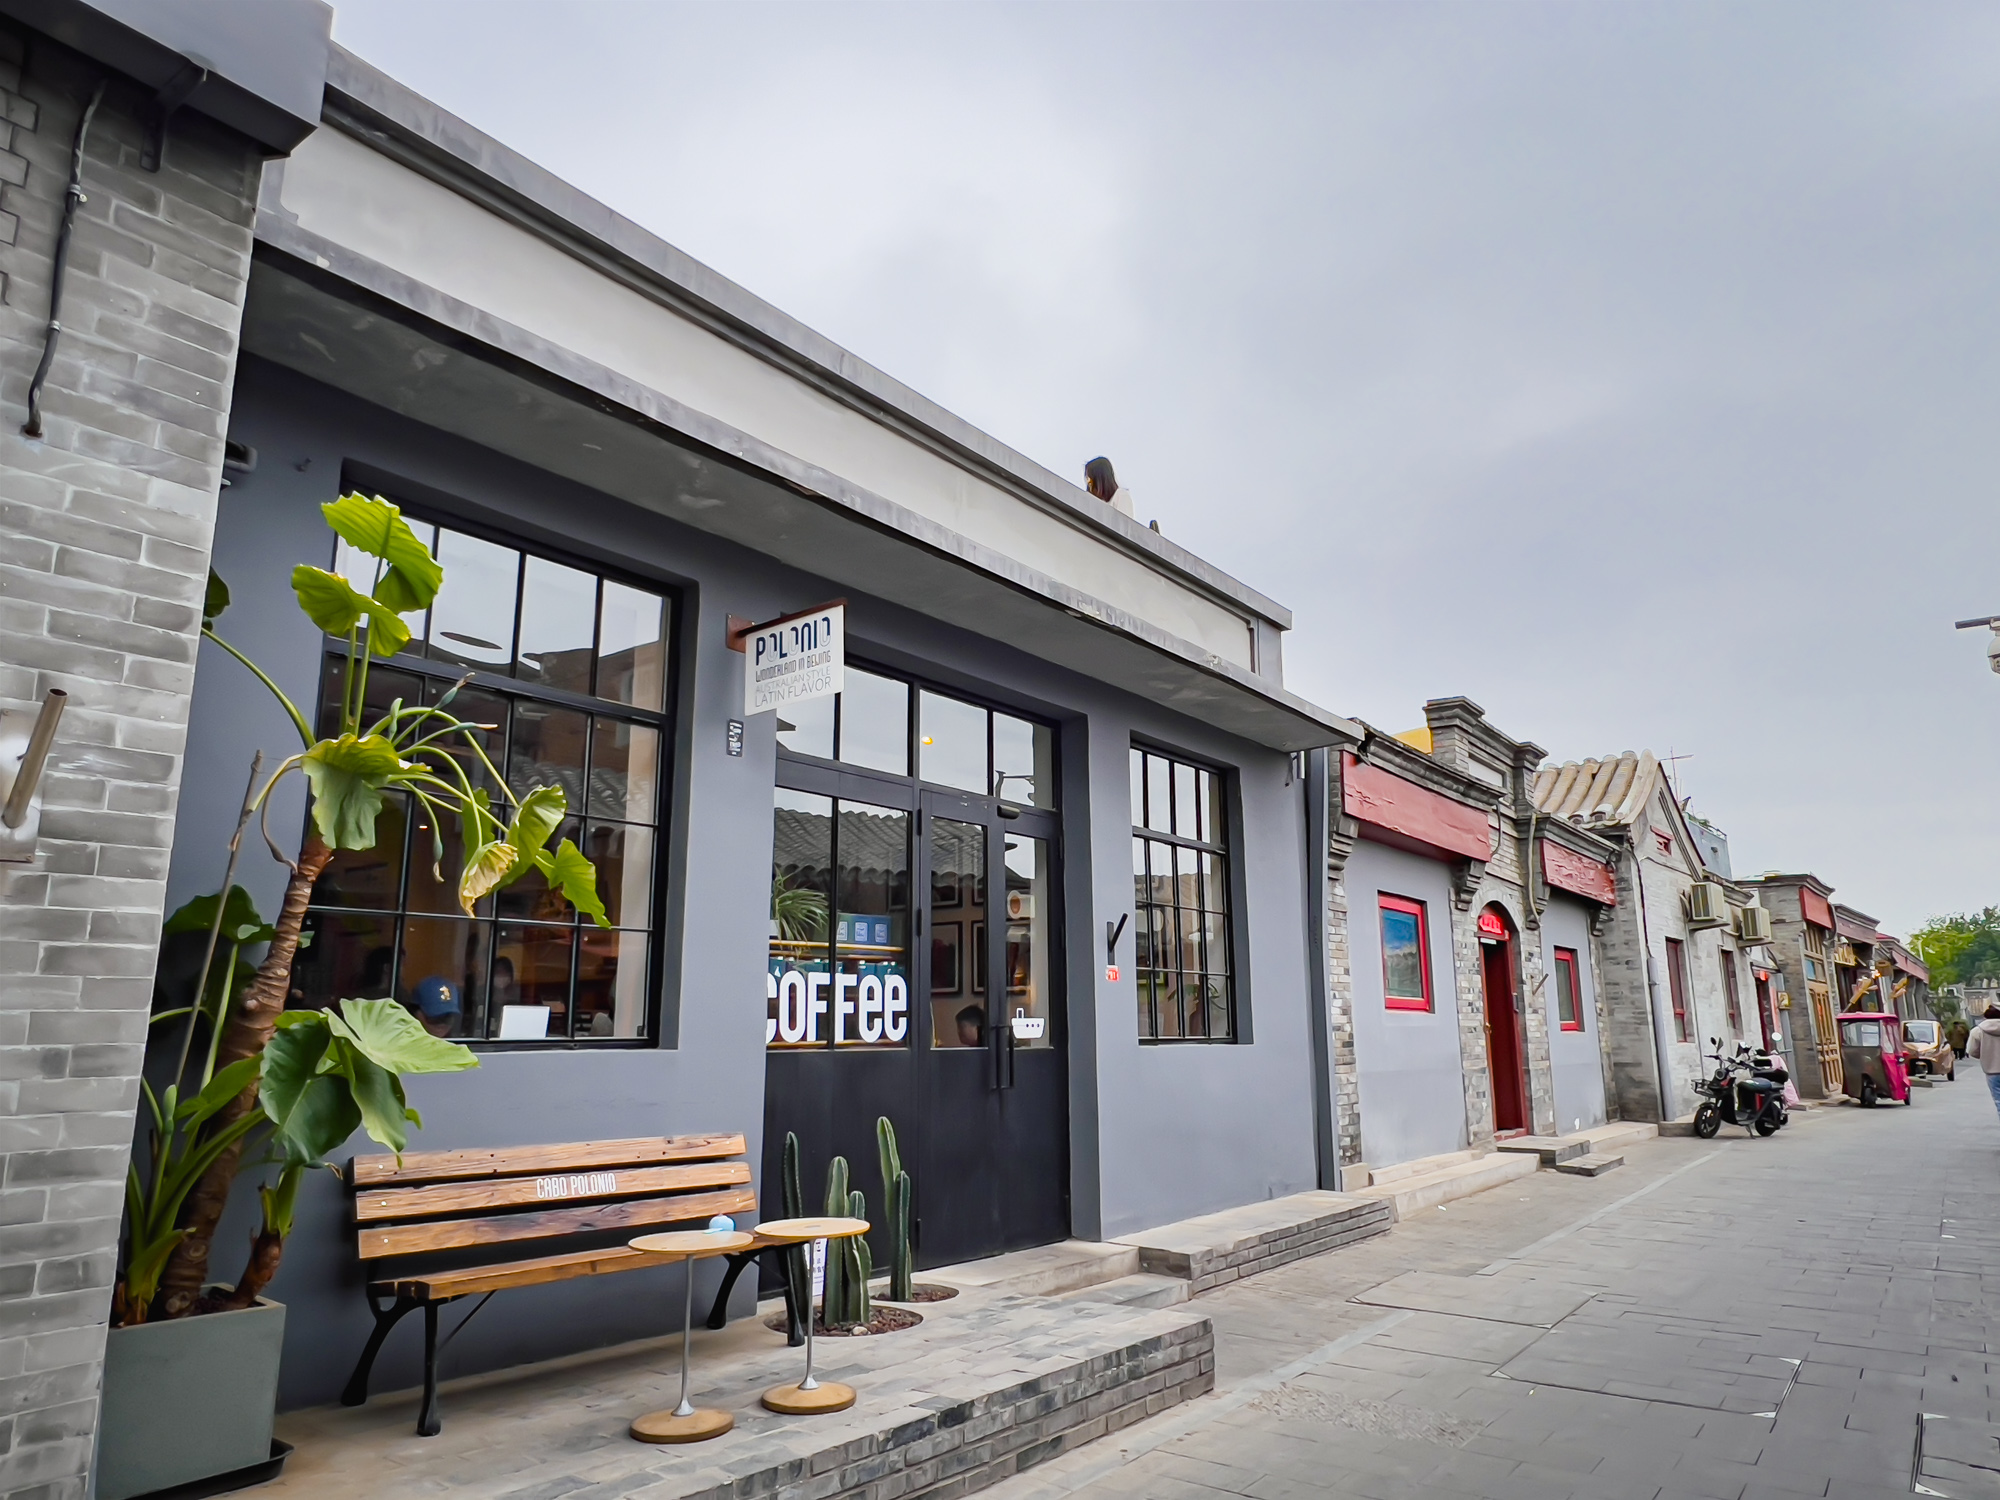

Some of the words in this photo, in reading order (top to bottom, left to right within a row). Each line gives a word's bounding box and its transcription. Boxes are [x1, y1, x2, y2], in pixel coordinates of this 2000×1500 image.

[756, 616, 831, 666] POLONIO
[755, 688, 785, 707] LATIN
[788, 676, 832, 698] FLAVOR
[756, 674, 804, 693] AUSTRALIAN
[806, 666, 831, 680] STYLE
[536, 1176, 568, 1199] CABO
[570, 1172, 617, 1196] POLONIO
